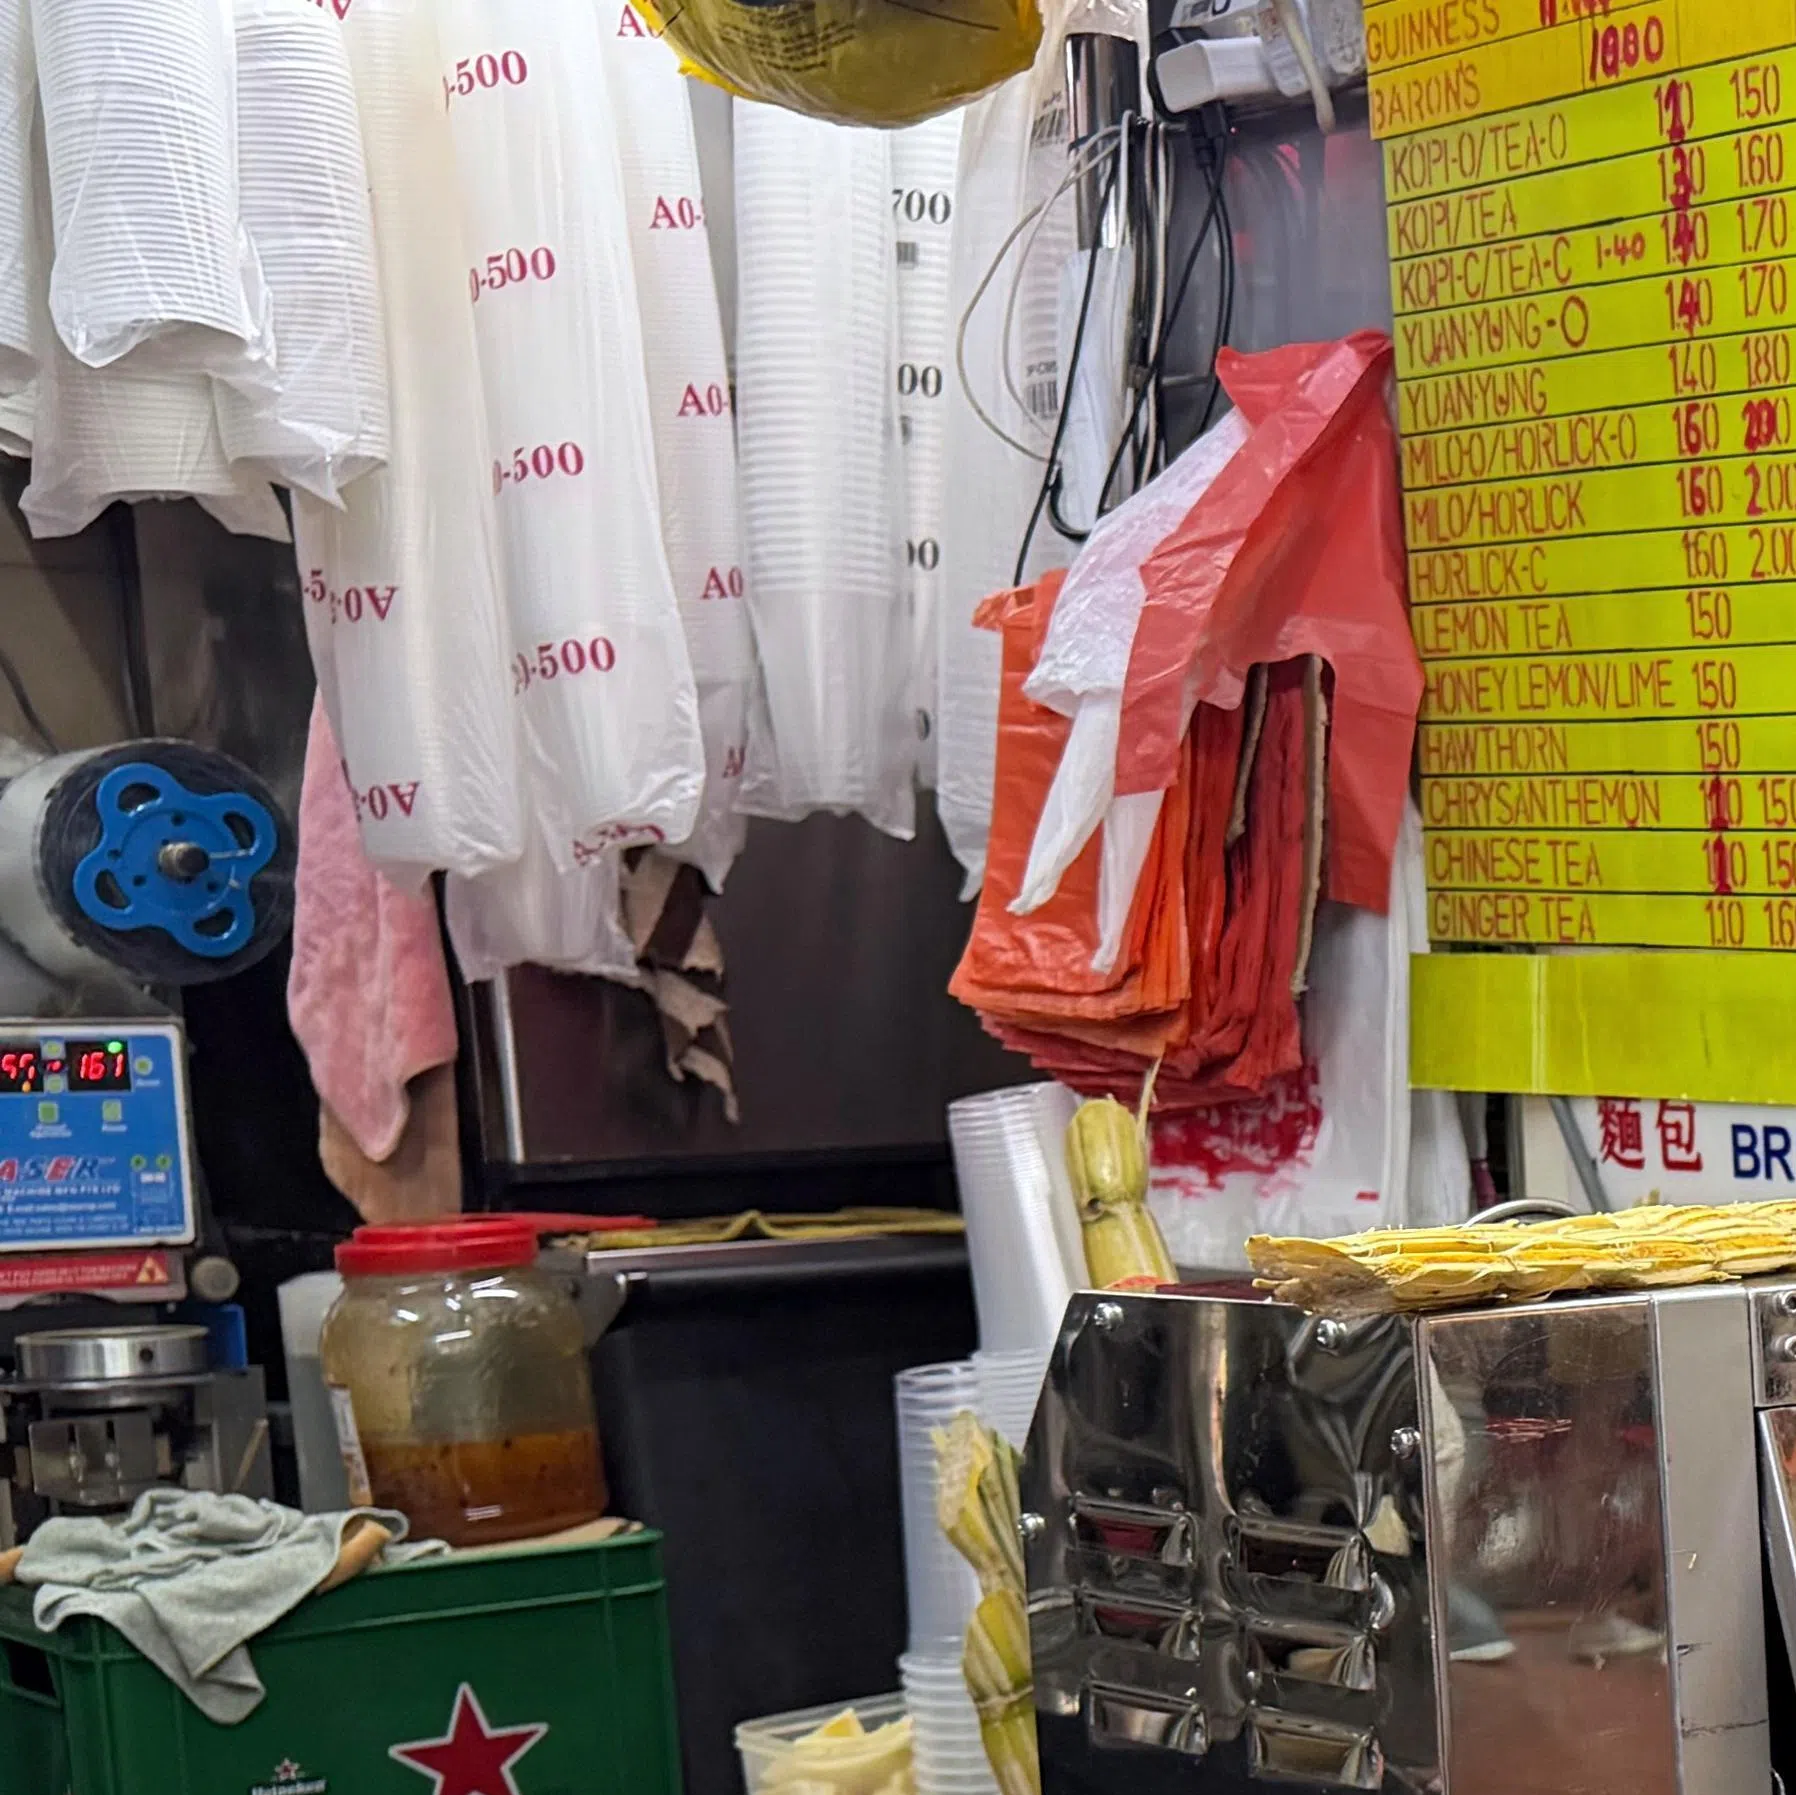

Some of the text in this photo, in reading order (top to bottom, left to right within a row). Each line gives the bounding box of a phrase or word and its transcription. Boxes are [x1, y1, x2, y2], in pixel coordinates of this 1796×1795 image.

[1366, 0, 1500, 64] GUINNESS
[1395, 188, 1517, 253] KOPI/TEA
[1419, 605, 1509, 656] LEMON
[1519, 604, 1573, 650] TEA
[1425, 665, 1508, 715] HONEY
[1422, 725, 1569, 772] HAWTHORN
[1431, 837, 1543, 885] CHINESE
[1546, 840, 1603, 887] TEA
[1433, 893, 1530, 941] GINGER
[1539, 897, 1597, 943] TEA
